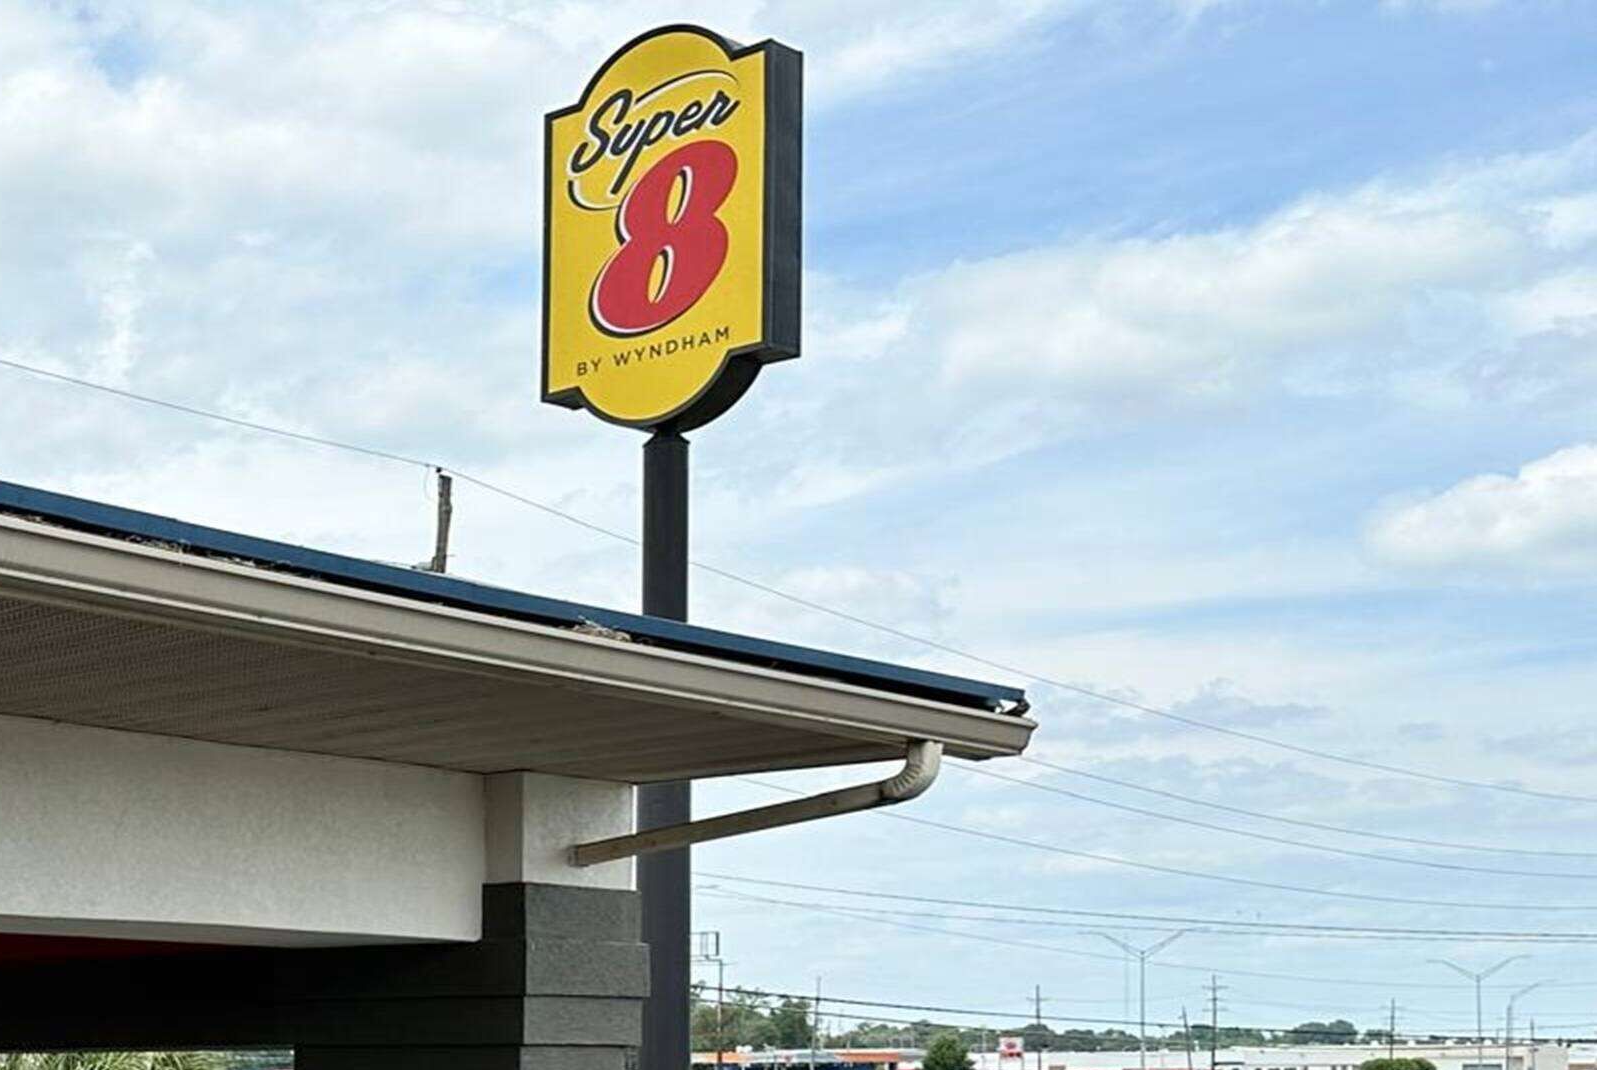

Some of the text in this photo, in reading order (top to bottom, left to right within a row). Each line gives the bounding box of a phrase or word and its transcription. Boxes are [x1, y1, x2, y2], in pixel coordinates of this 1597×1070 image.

[570, 88, 741, 195] Super
[588, 139, 739, 339] 8
[576, 326, 731, 377] BY WYNDHAM
